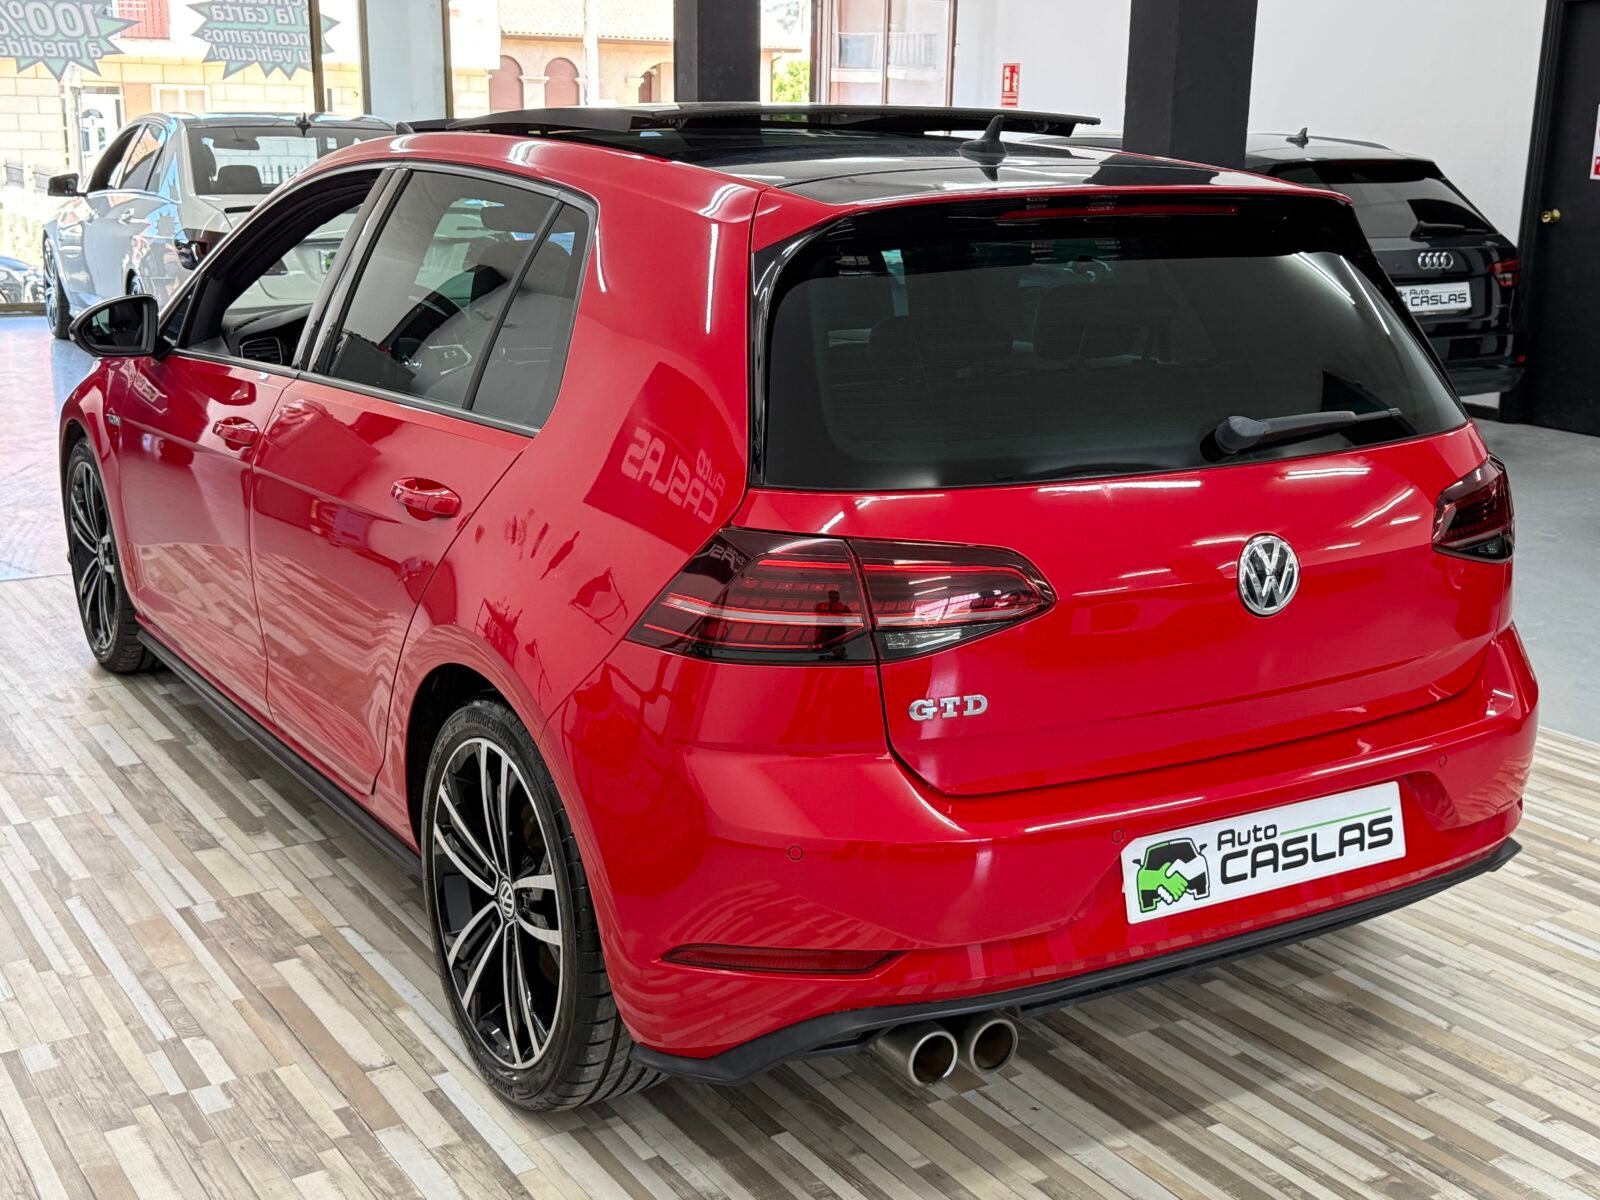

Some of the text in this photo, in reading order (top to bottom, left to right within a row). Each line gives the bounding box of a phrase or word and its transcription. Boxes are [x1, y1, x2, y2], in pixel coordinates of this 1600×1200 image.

[1410, 293, 1467, 307] CASLAS
[908, 694, 989, 722] GTD
[1217, 823, 1278, 851] Auto
[1220, 815, 1393, 885] CASLAS
